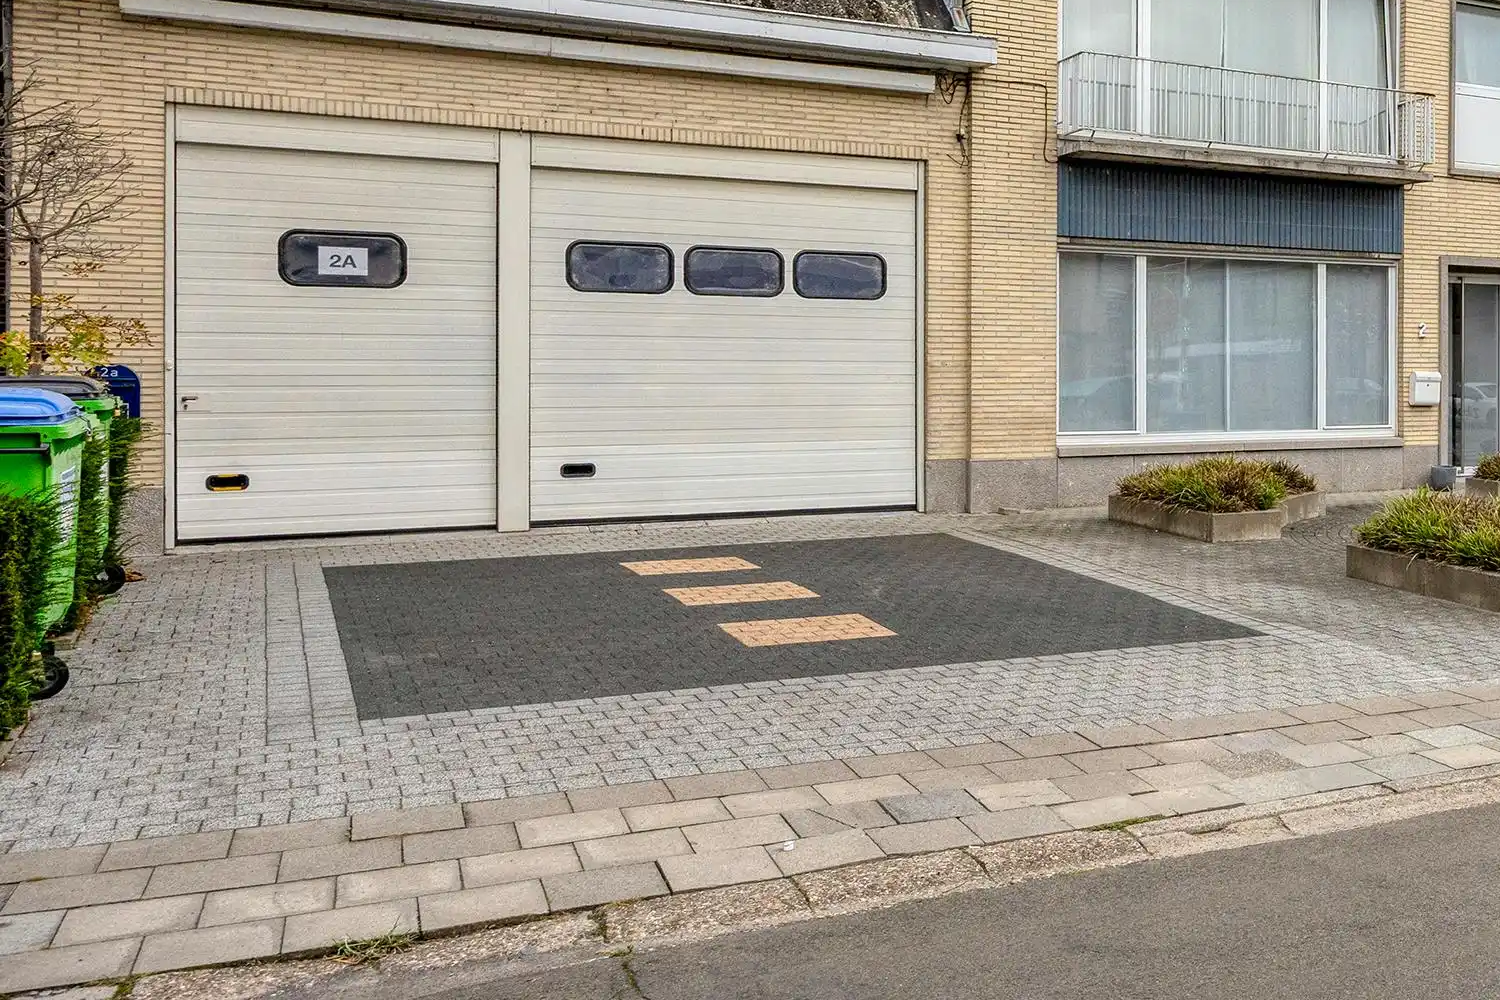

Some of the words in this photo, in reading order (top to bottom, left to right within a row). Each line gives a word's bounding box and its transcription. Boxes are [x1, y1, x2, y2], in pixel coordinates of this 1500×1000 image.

[329, 254, 357, 269] 2A
[1418, 322, 1428, 338] 2
[100, 367, 119, 378] 2a
